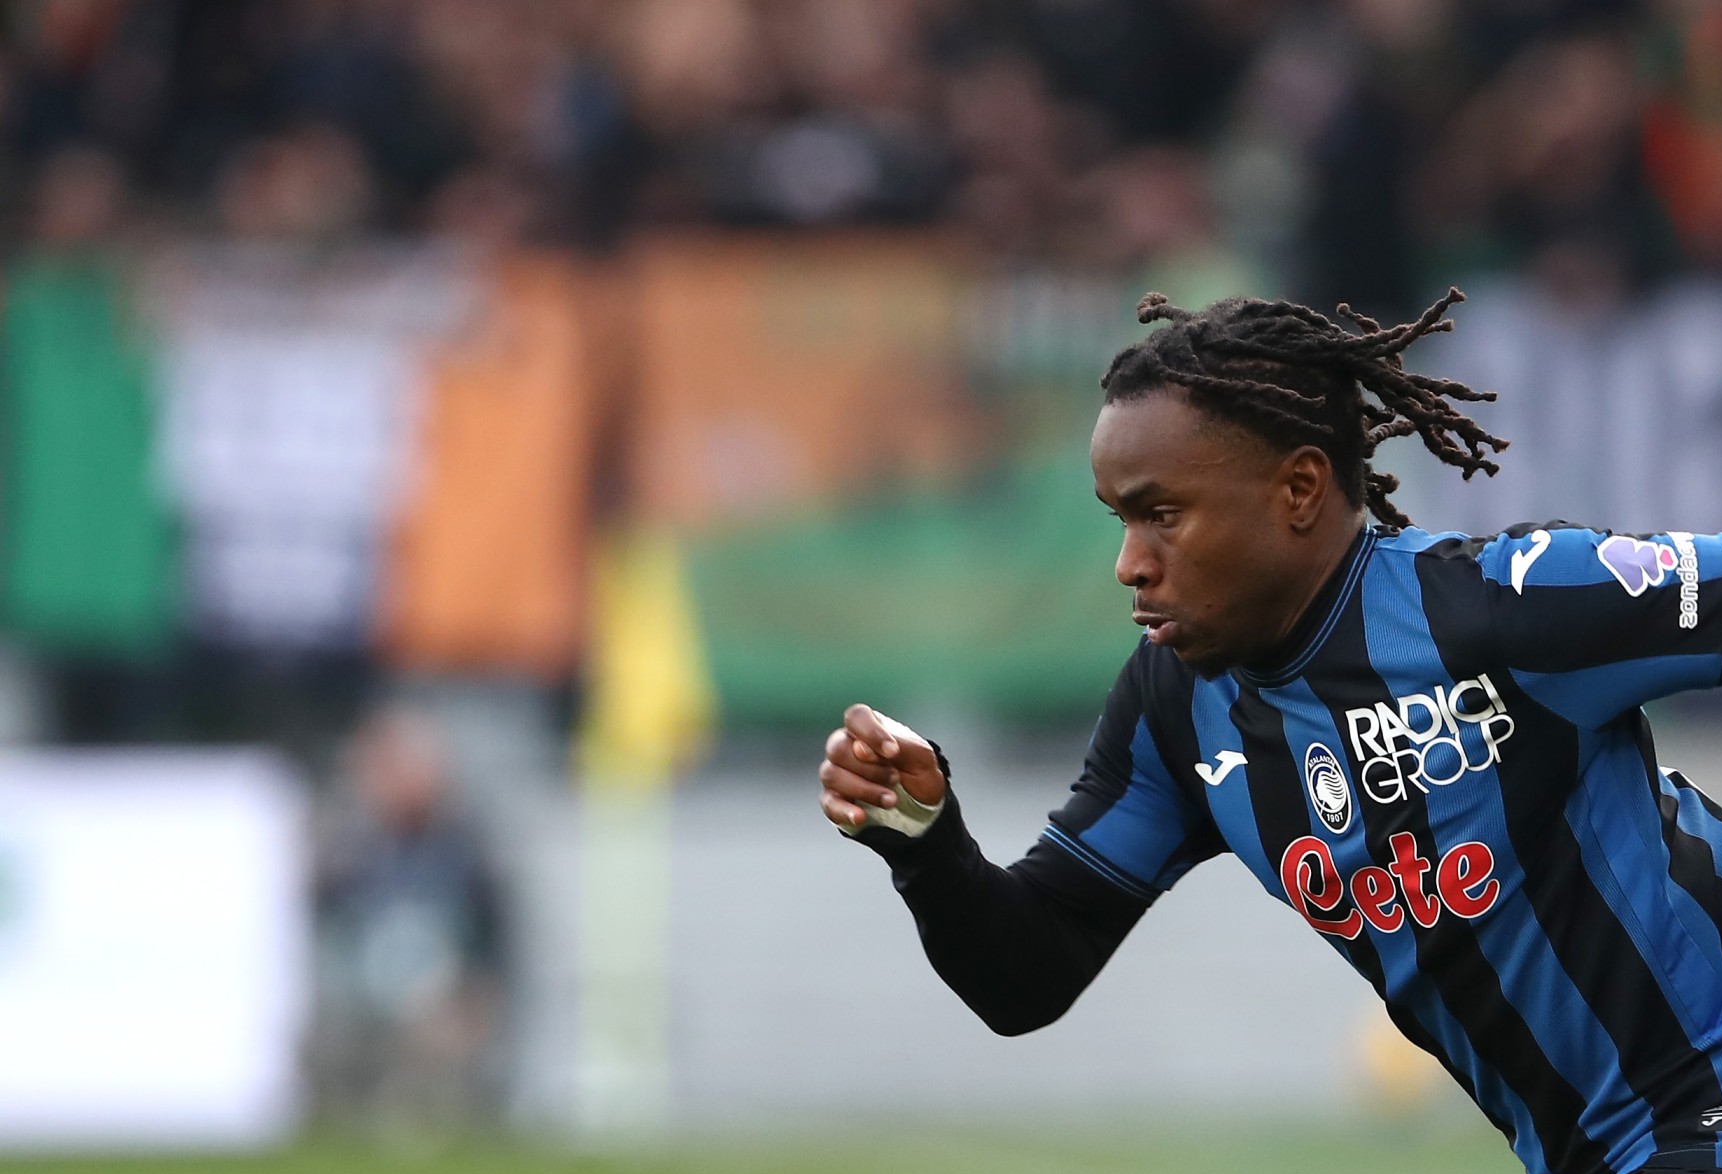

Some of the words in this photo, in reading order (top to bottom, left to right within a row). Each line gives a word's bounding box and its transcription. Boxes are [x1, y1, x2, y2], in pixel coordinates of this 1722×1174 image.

[1679, 531, 1699, 628] zondac
[1308, 755, 1336, 769] ATALANTA
[1345, 673, 1507, 762] RADICI
[1361, 714, 1515, 804] GROUP
[1326, 811, 1344, 823] 1907
